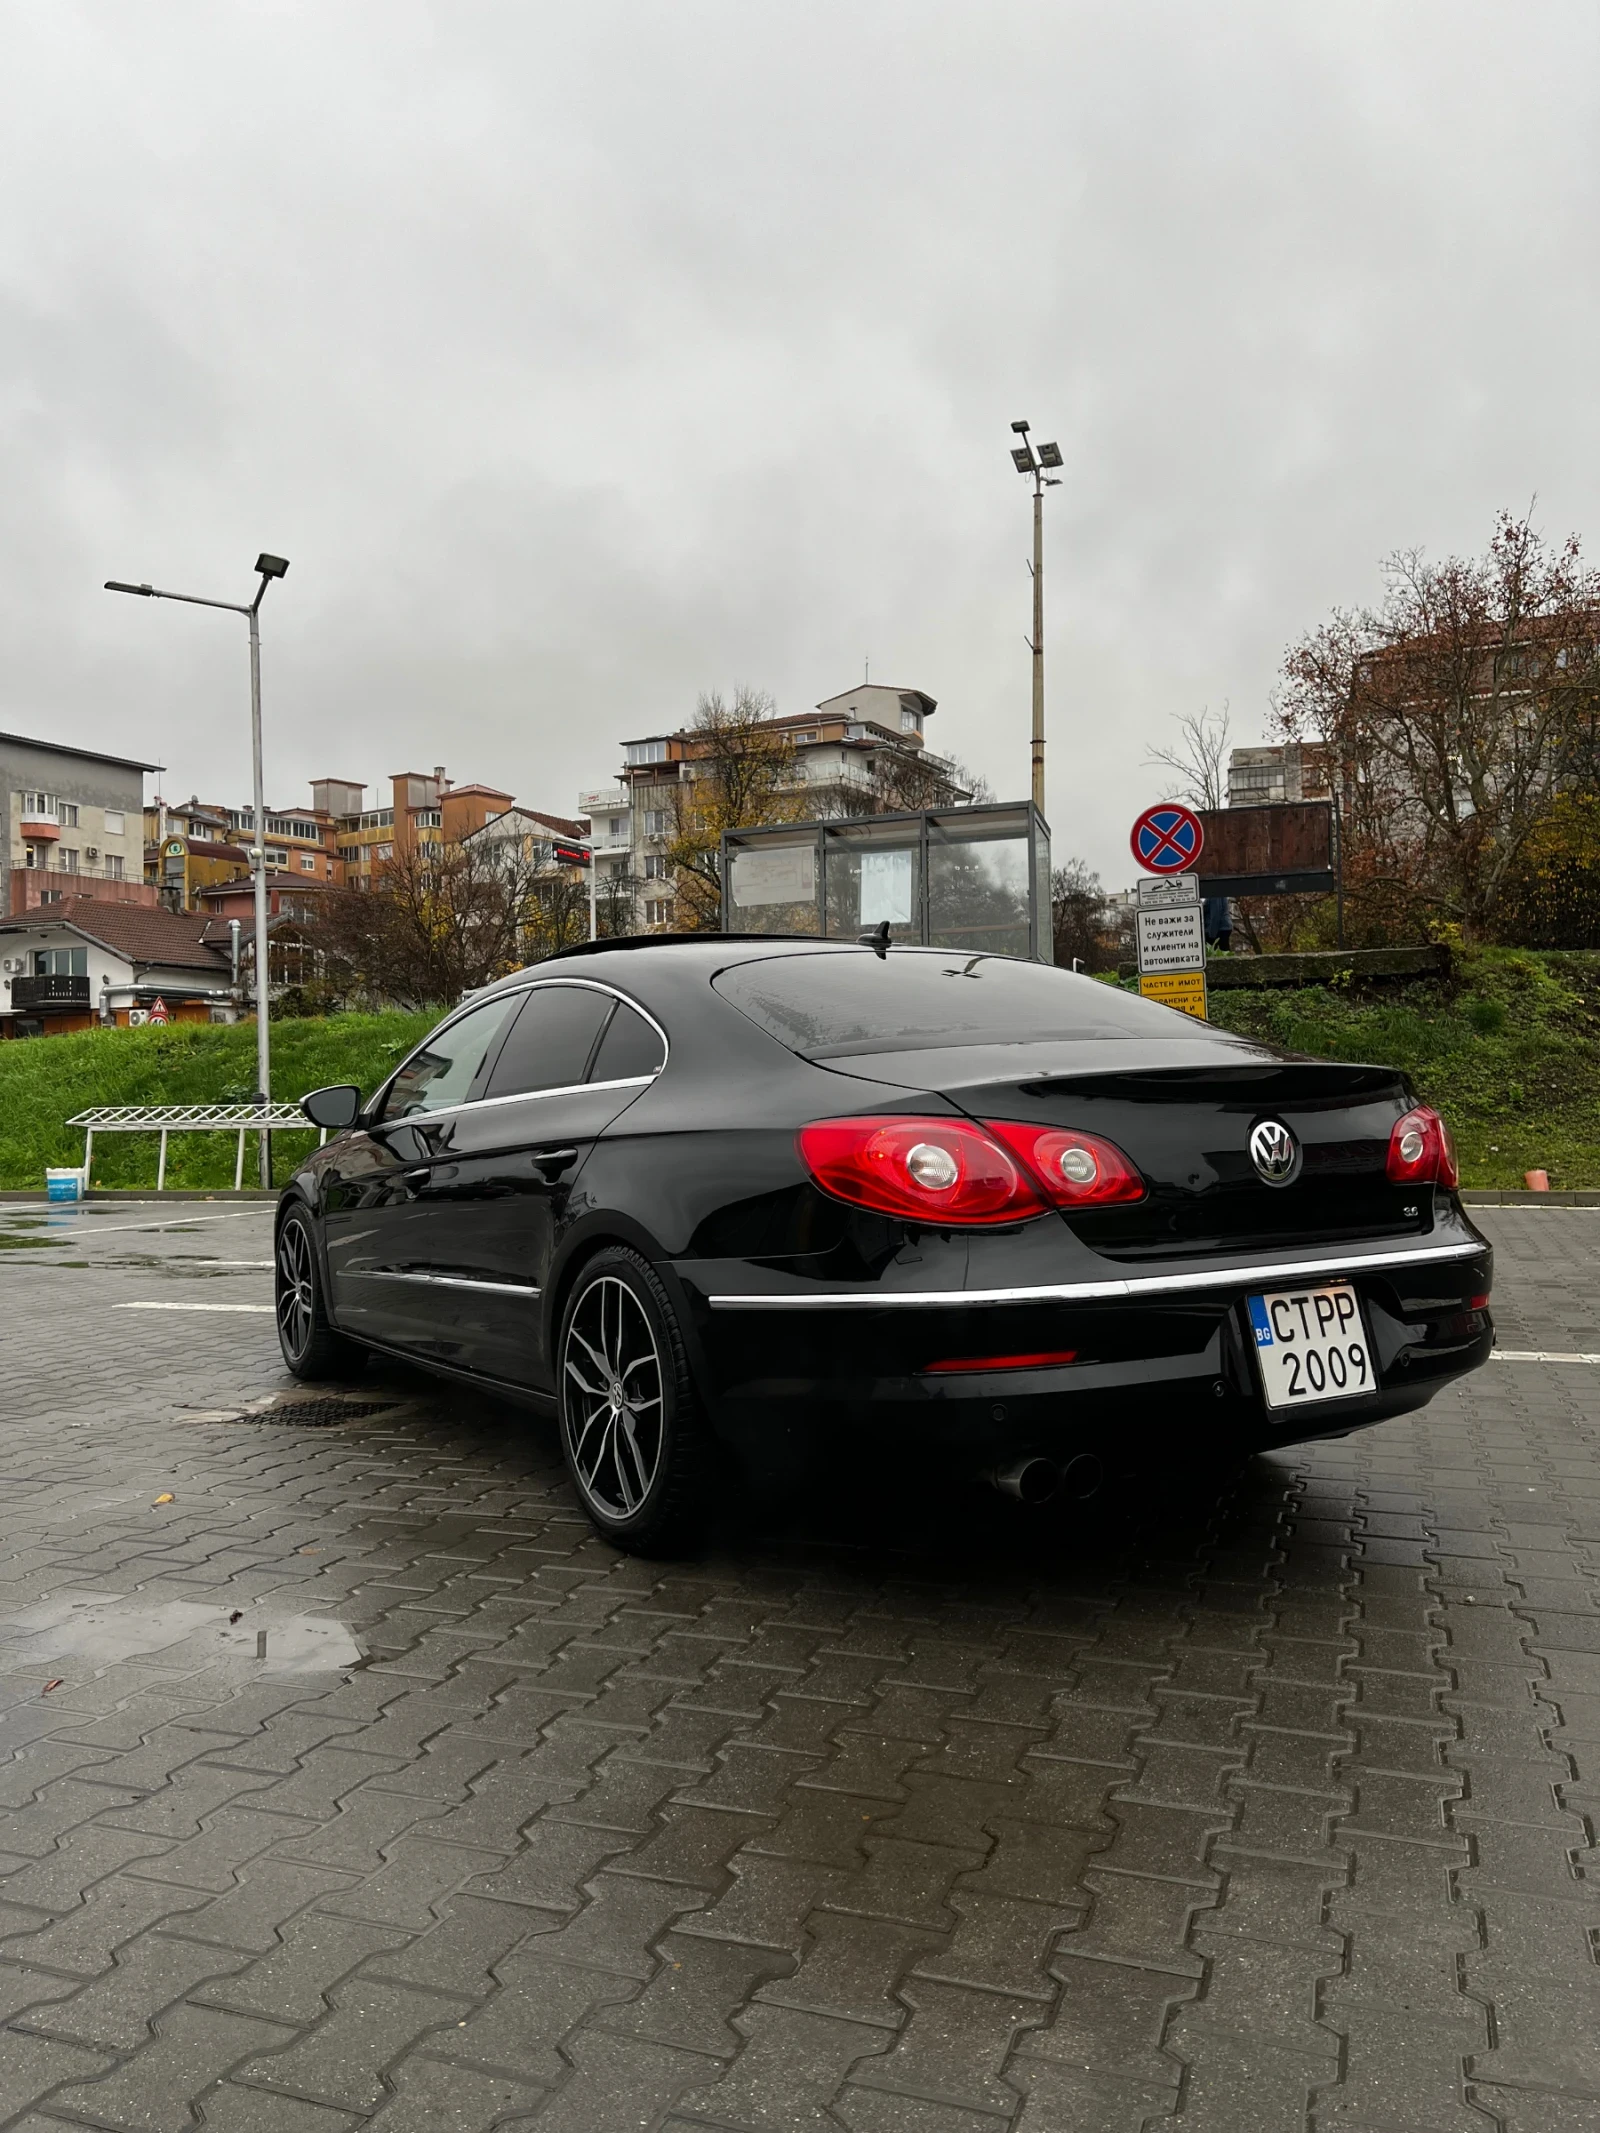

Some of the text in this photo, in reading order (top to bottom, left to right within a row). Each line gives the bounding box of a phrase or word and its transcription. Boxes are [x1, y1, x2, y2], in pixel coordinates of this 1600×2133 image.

[1144, 914, 1194, 926] Не важи за
[1146, 928, 1194, 941] служители
[1151, 942, 1186, 952] клиенти
[1188, 941, 1199, 949] на
[1144, 954, 1200, 966] автомивката
[1143, 978, 1201, 989] ЧАСТЕН ИМОТ
[1255, 1292, 1355, 1342] BG CTPP
[1282, 1343, 1366, 1397] 2009
